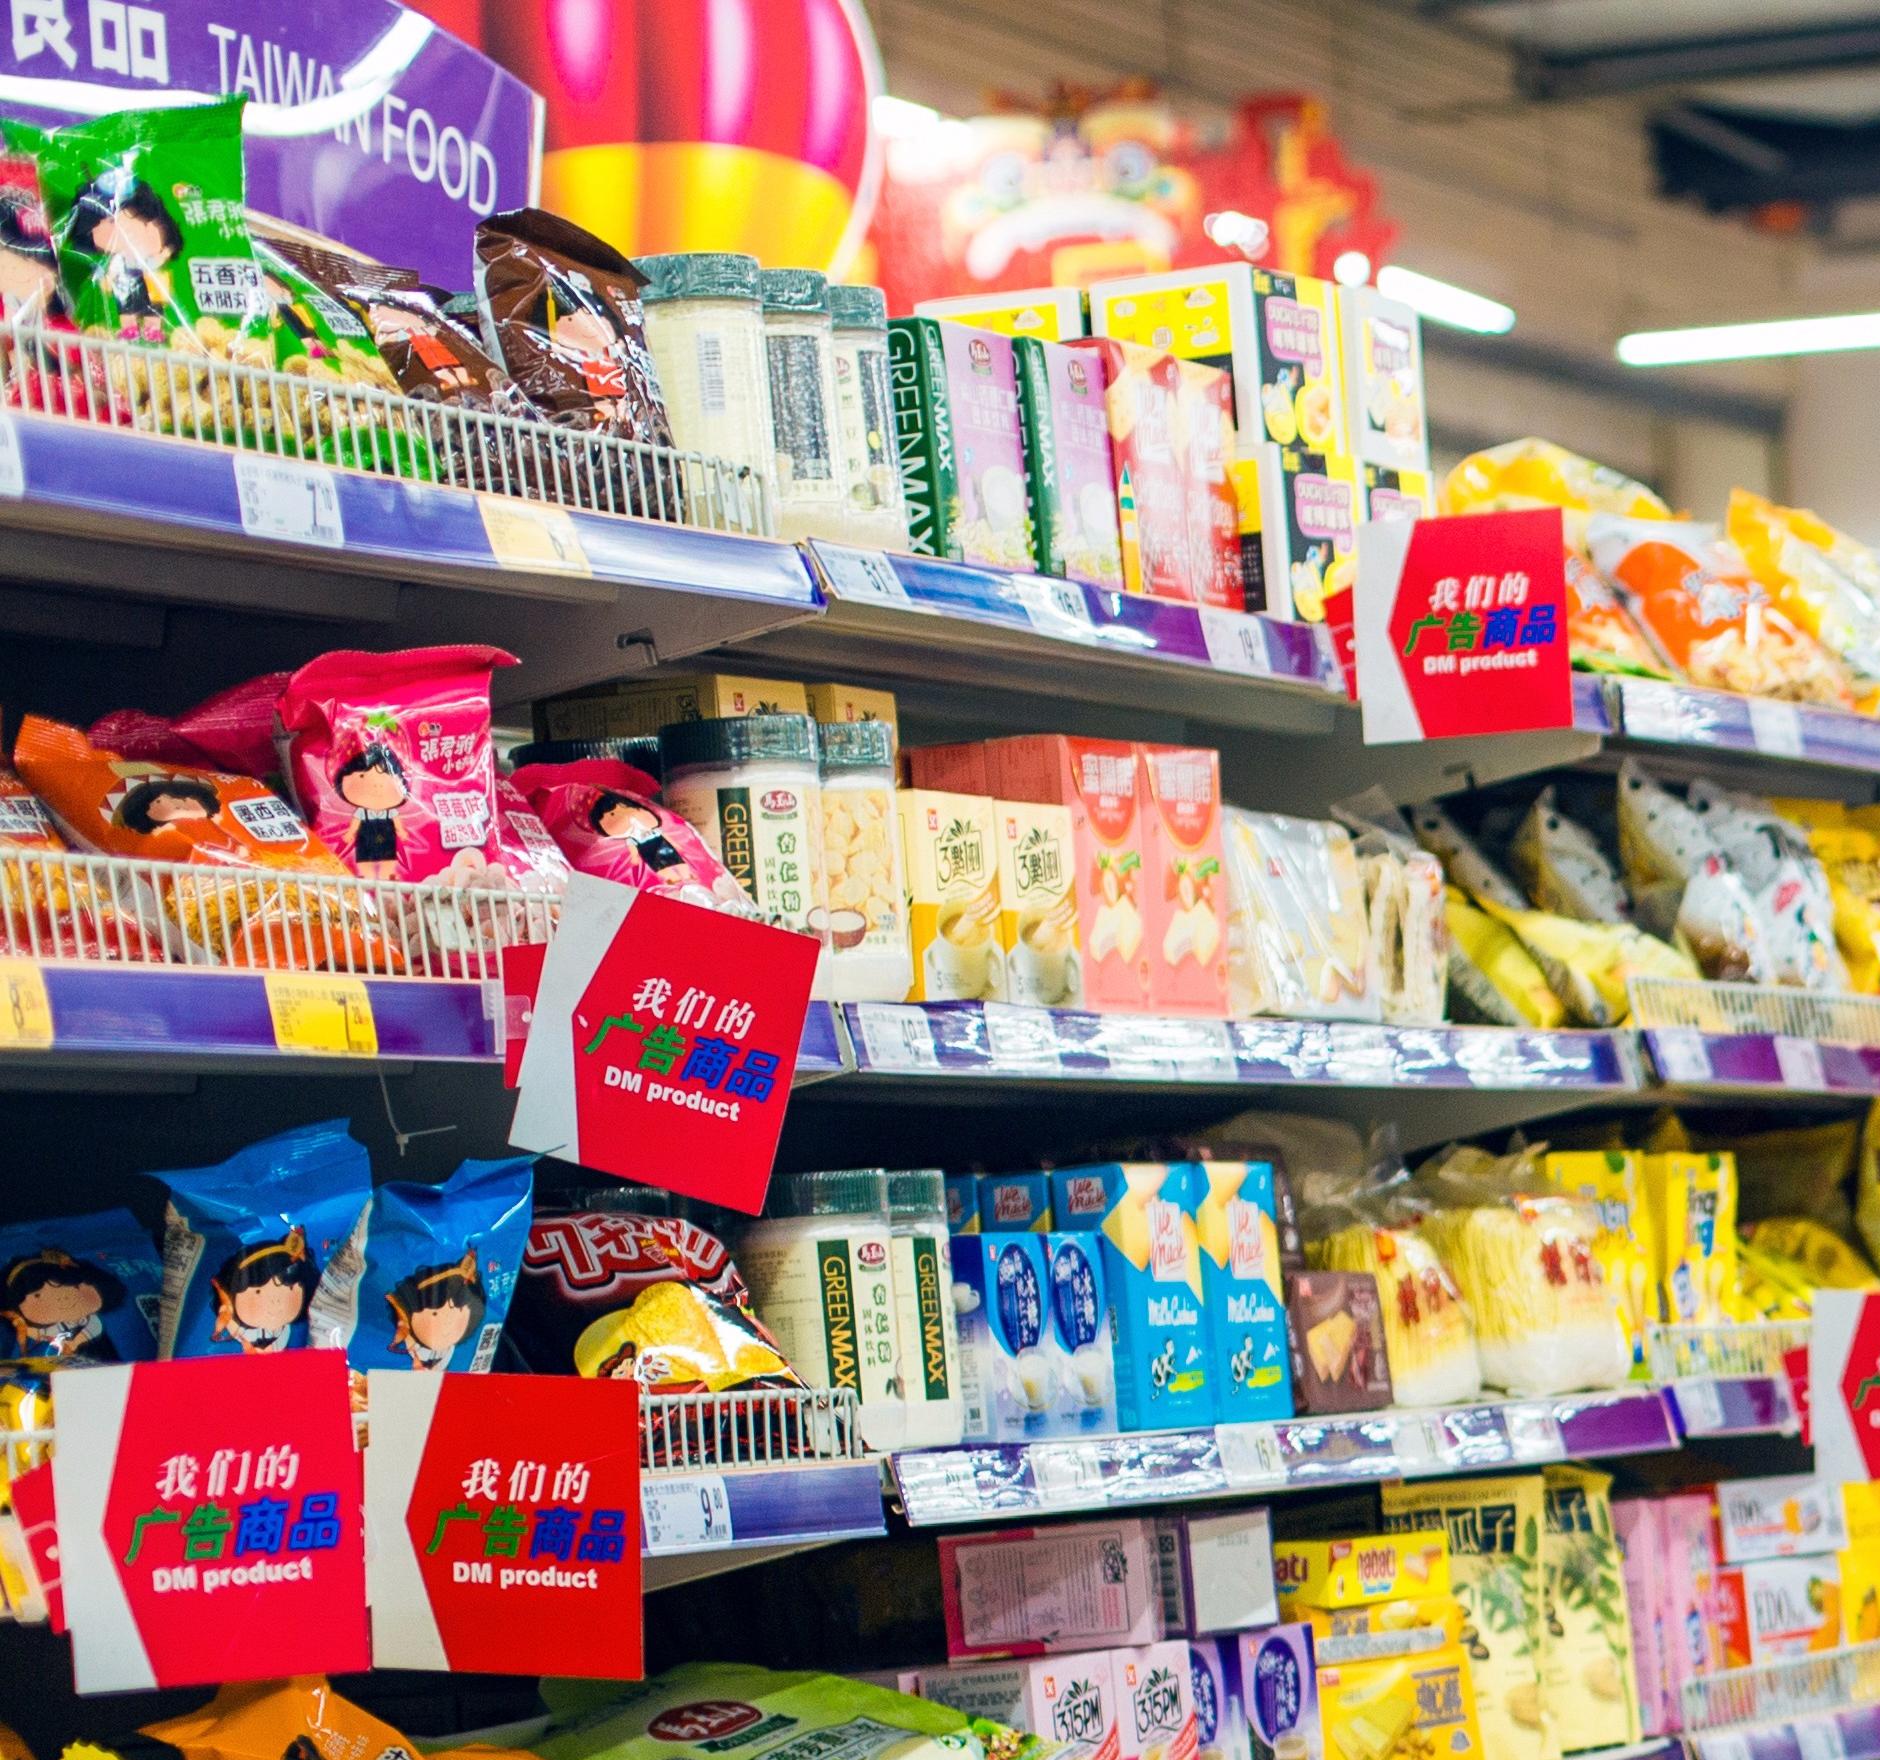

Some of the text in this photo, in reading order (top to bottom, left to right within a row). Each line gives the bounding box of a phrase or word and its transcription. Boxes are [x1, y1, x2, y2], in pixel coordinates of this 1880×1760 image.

[381, 97, 499, 215] FOOD
[925, 325, 953, 478] GREENMAX
[1031, 344, 1055, 488] GREENMAX
[887, 326, 936, 558] GREENMAX
[305, 477, 318, 528] 7
[1428, 572, 1531, 611] 我们的
[1404, 603, 1557, 658] 广告商品
[1423, 648, 1538, 676] DM product
[336, 995, 351, 1052] 7
[631, 976, 757, 1041] 我们的
[582, 1012, 783, 1102] 广告商品
[603, 1067, 741, 1123] DM product
[823, 1255, 858, 1389] GREENMAX
[917, 1252, 946, 1385] GREENMAX
[156, 1445, 300, 1502] 我们的
[461, 1459, 591, 1503] 我们的
[123, 1492, 341, 1567] 广告商品
[426, 1505, 627, 1564] 广告商品
[700, 1487, 713, 1528] 9
[152, 1556, 312, 1594] DM product
[452, 1562, 598, 1590] DM product
[1357, 1548, 1397, 1582] nabati
[1755, 1587, 1789, 1629] EDO
